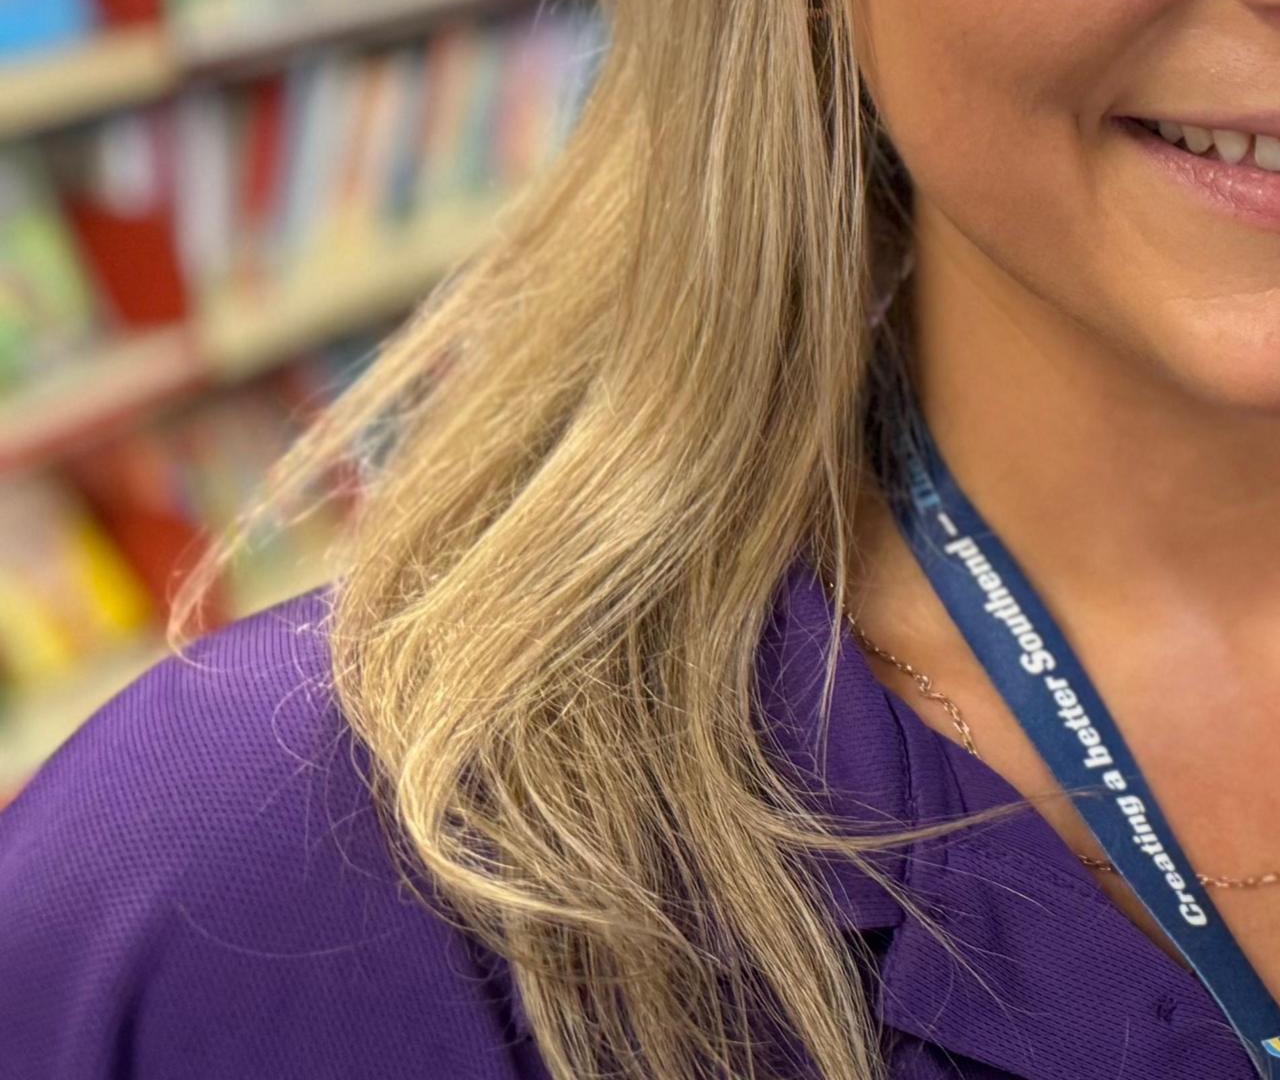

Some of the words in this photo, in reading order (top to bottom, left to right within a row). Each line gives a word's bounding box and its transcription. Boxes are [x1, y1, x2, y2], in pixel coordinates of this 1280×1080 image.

[944, 536, 1056, 675] Southend
[1044, 677, 1113, 768] better
[1102, 770, 1127, 791] a
[1115, 795, 1207, 926] Creating
